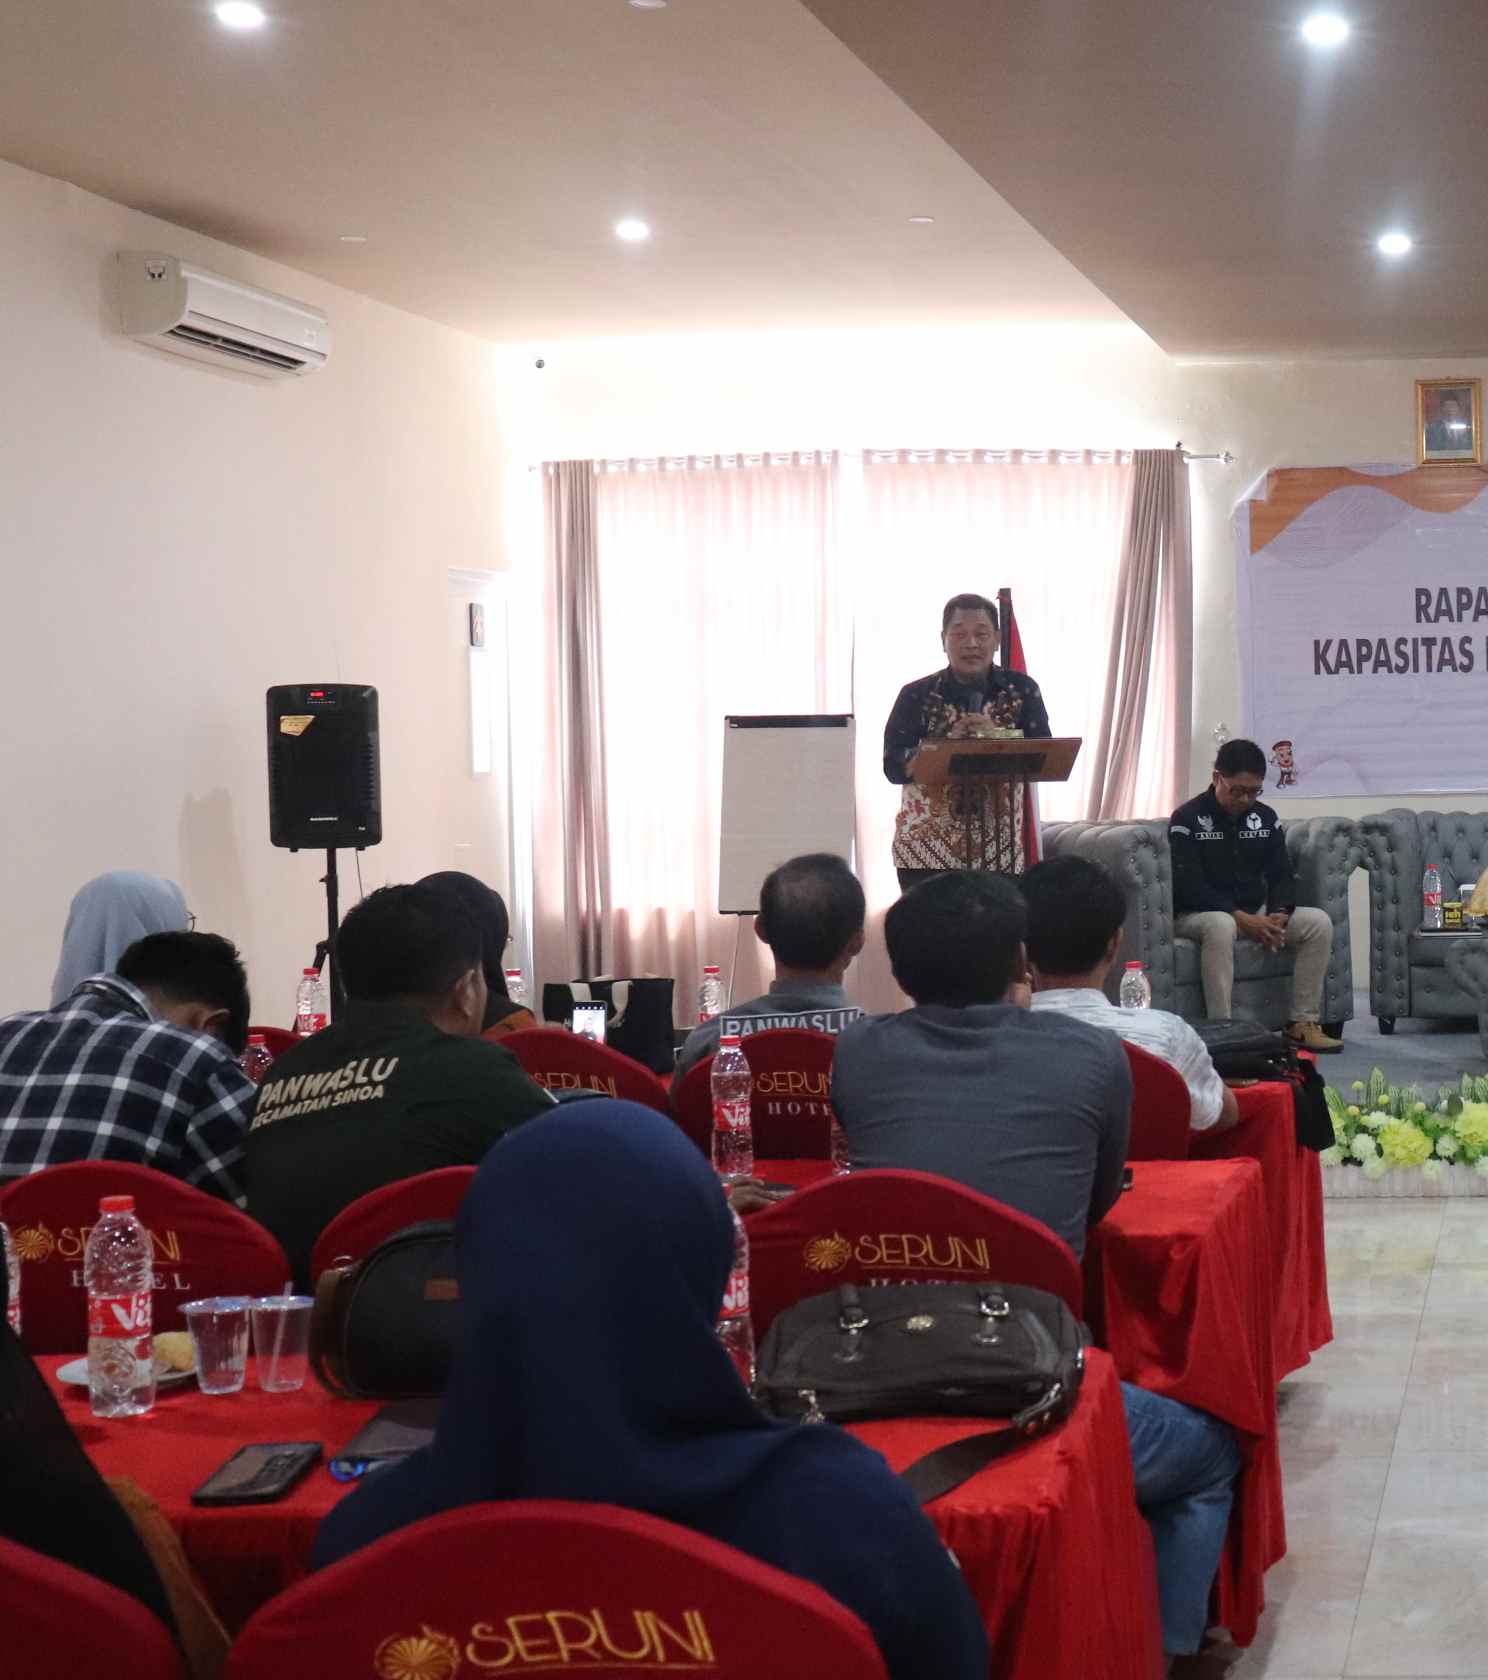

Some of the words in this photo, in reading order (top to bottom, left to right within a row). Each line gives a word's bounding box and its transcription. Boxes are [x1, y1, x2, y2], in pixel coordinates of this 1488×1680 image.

[1313, 636, 1475, 675] KAPASITAS
[256, 1057, 400, 1112] PANWASLU
[331, 1084, 385, 1106] SINOA
[854, 1233, 991, 1270] SERUNI
[465, 1608, 715, 1668] SERUNI
